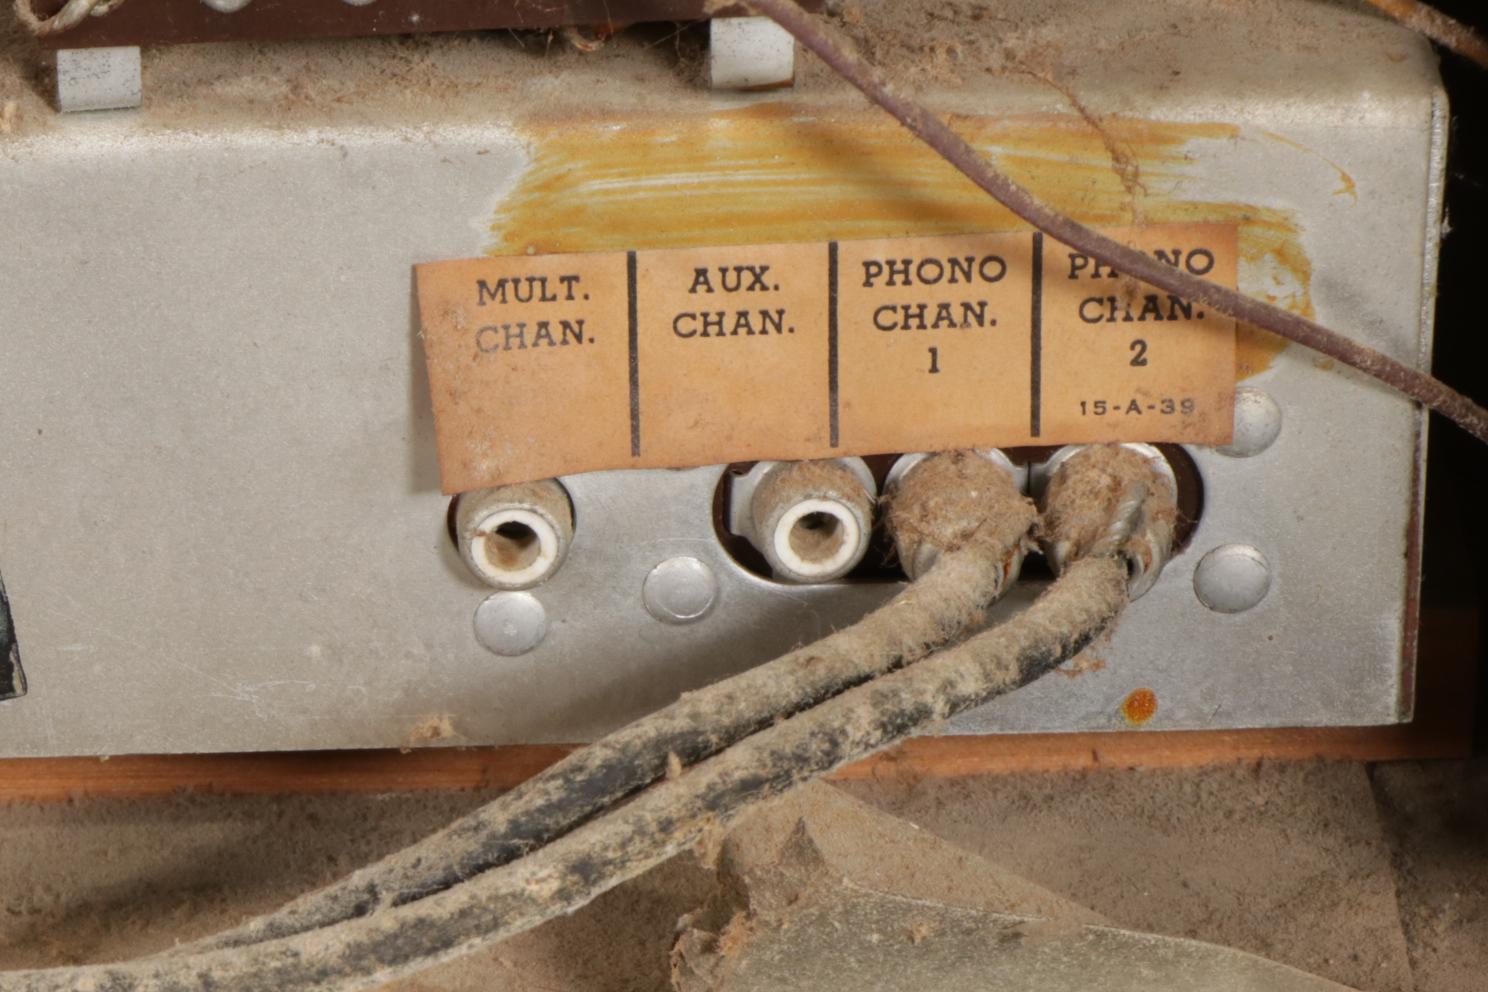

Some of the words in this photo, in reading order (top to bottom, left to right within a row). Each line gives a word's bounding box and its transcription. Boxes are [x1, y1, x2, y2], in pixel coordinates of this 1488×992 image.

[687, 264, 781, 294] AUX.
[861, 254, 1008, 288] PHONO
[1067, 247, 1216, 280] PHNO
[475, 275, 591, 306] MULT.
[671, 308, 796, 339] CHAN.
[872, 300, 999, 331] CHAN.
[1078, 293, 1206, 324] CHAN.
[474, 319, 596, 353] CHAN.
[926, 346, 942, 375] 1
[1129, 338, 1149, 368] 2
[1079, 398, 1196, 417] 15-A-39
